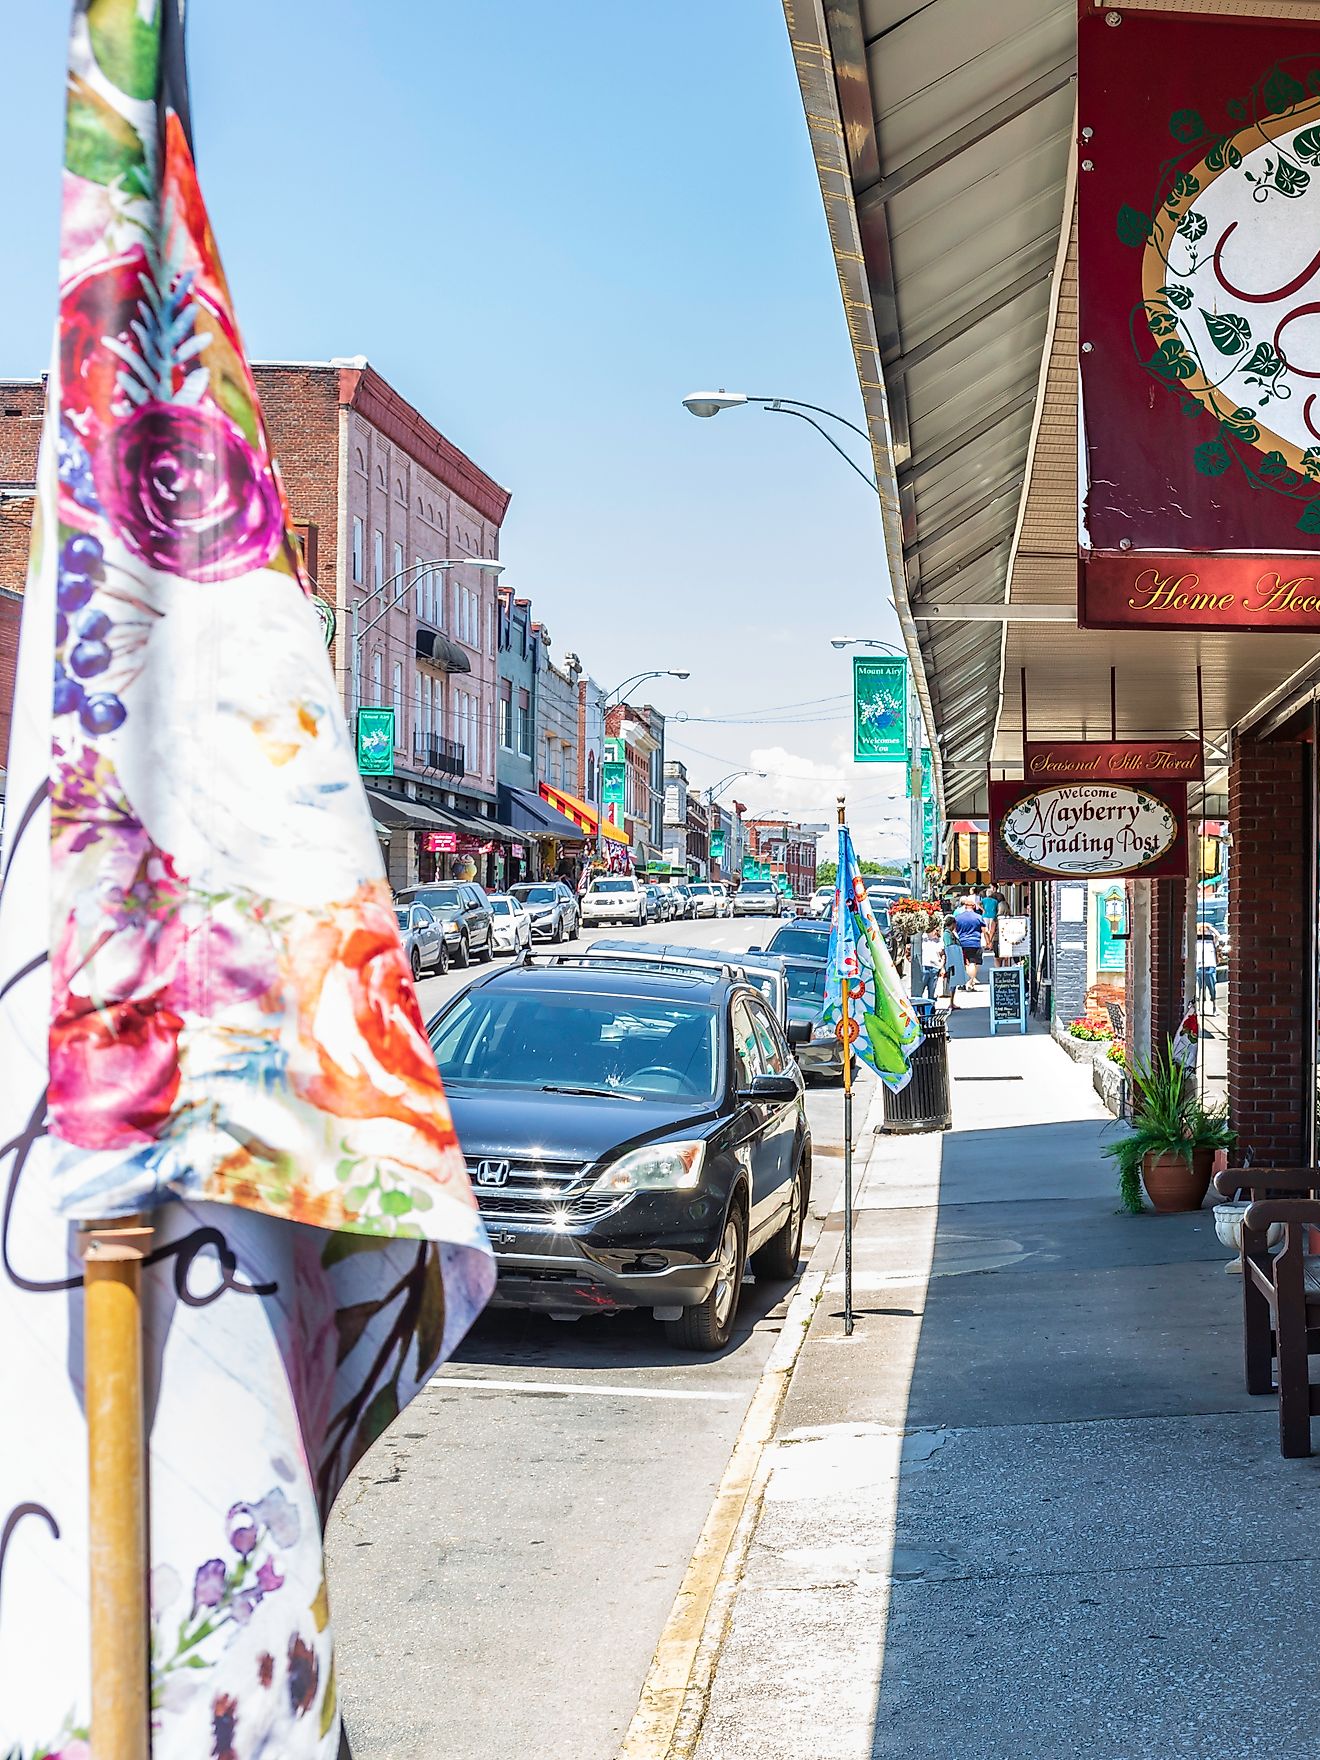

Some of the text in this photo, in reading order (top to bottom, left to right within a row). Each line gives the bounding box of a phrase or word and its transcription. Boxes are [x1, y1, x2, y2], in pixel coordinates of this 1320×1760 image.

[1128, 569, 1235, 611] Home
[858, 667, 902, 676] Mount Airy
[861, 736, 900, 744] Welcomes
[1029, 750, 1199, 775] Seasonal Silk Floral
[1057, 785, 1118, 801] Welcome
[1012, 797, 1141, 837] Mayberry
[1023, 827, 1161, 861] Trading Post
